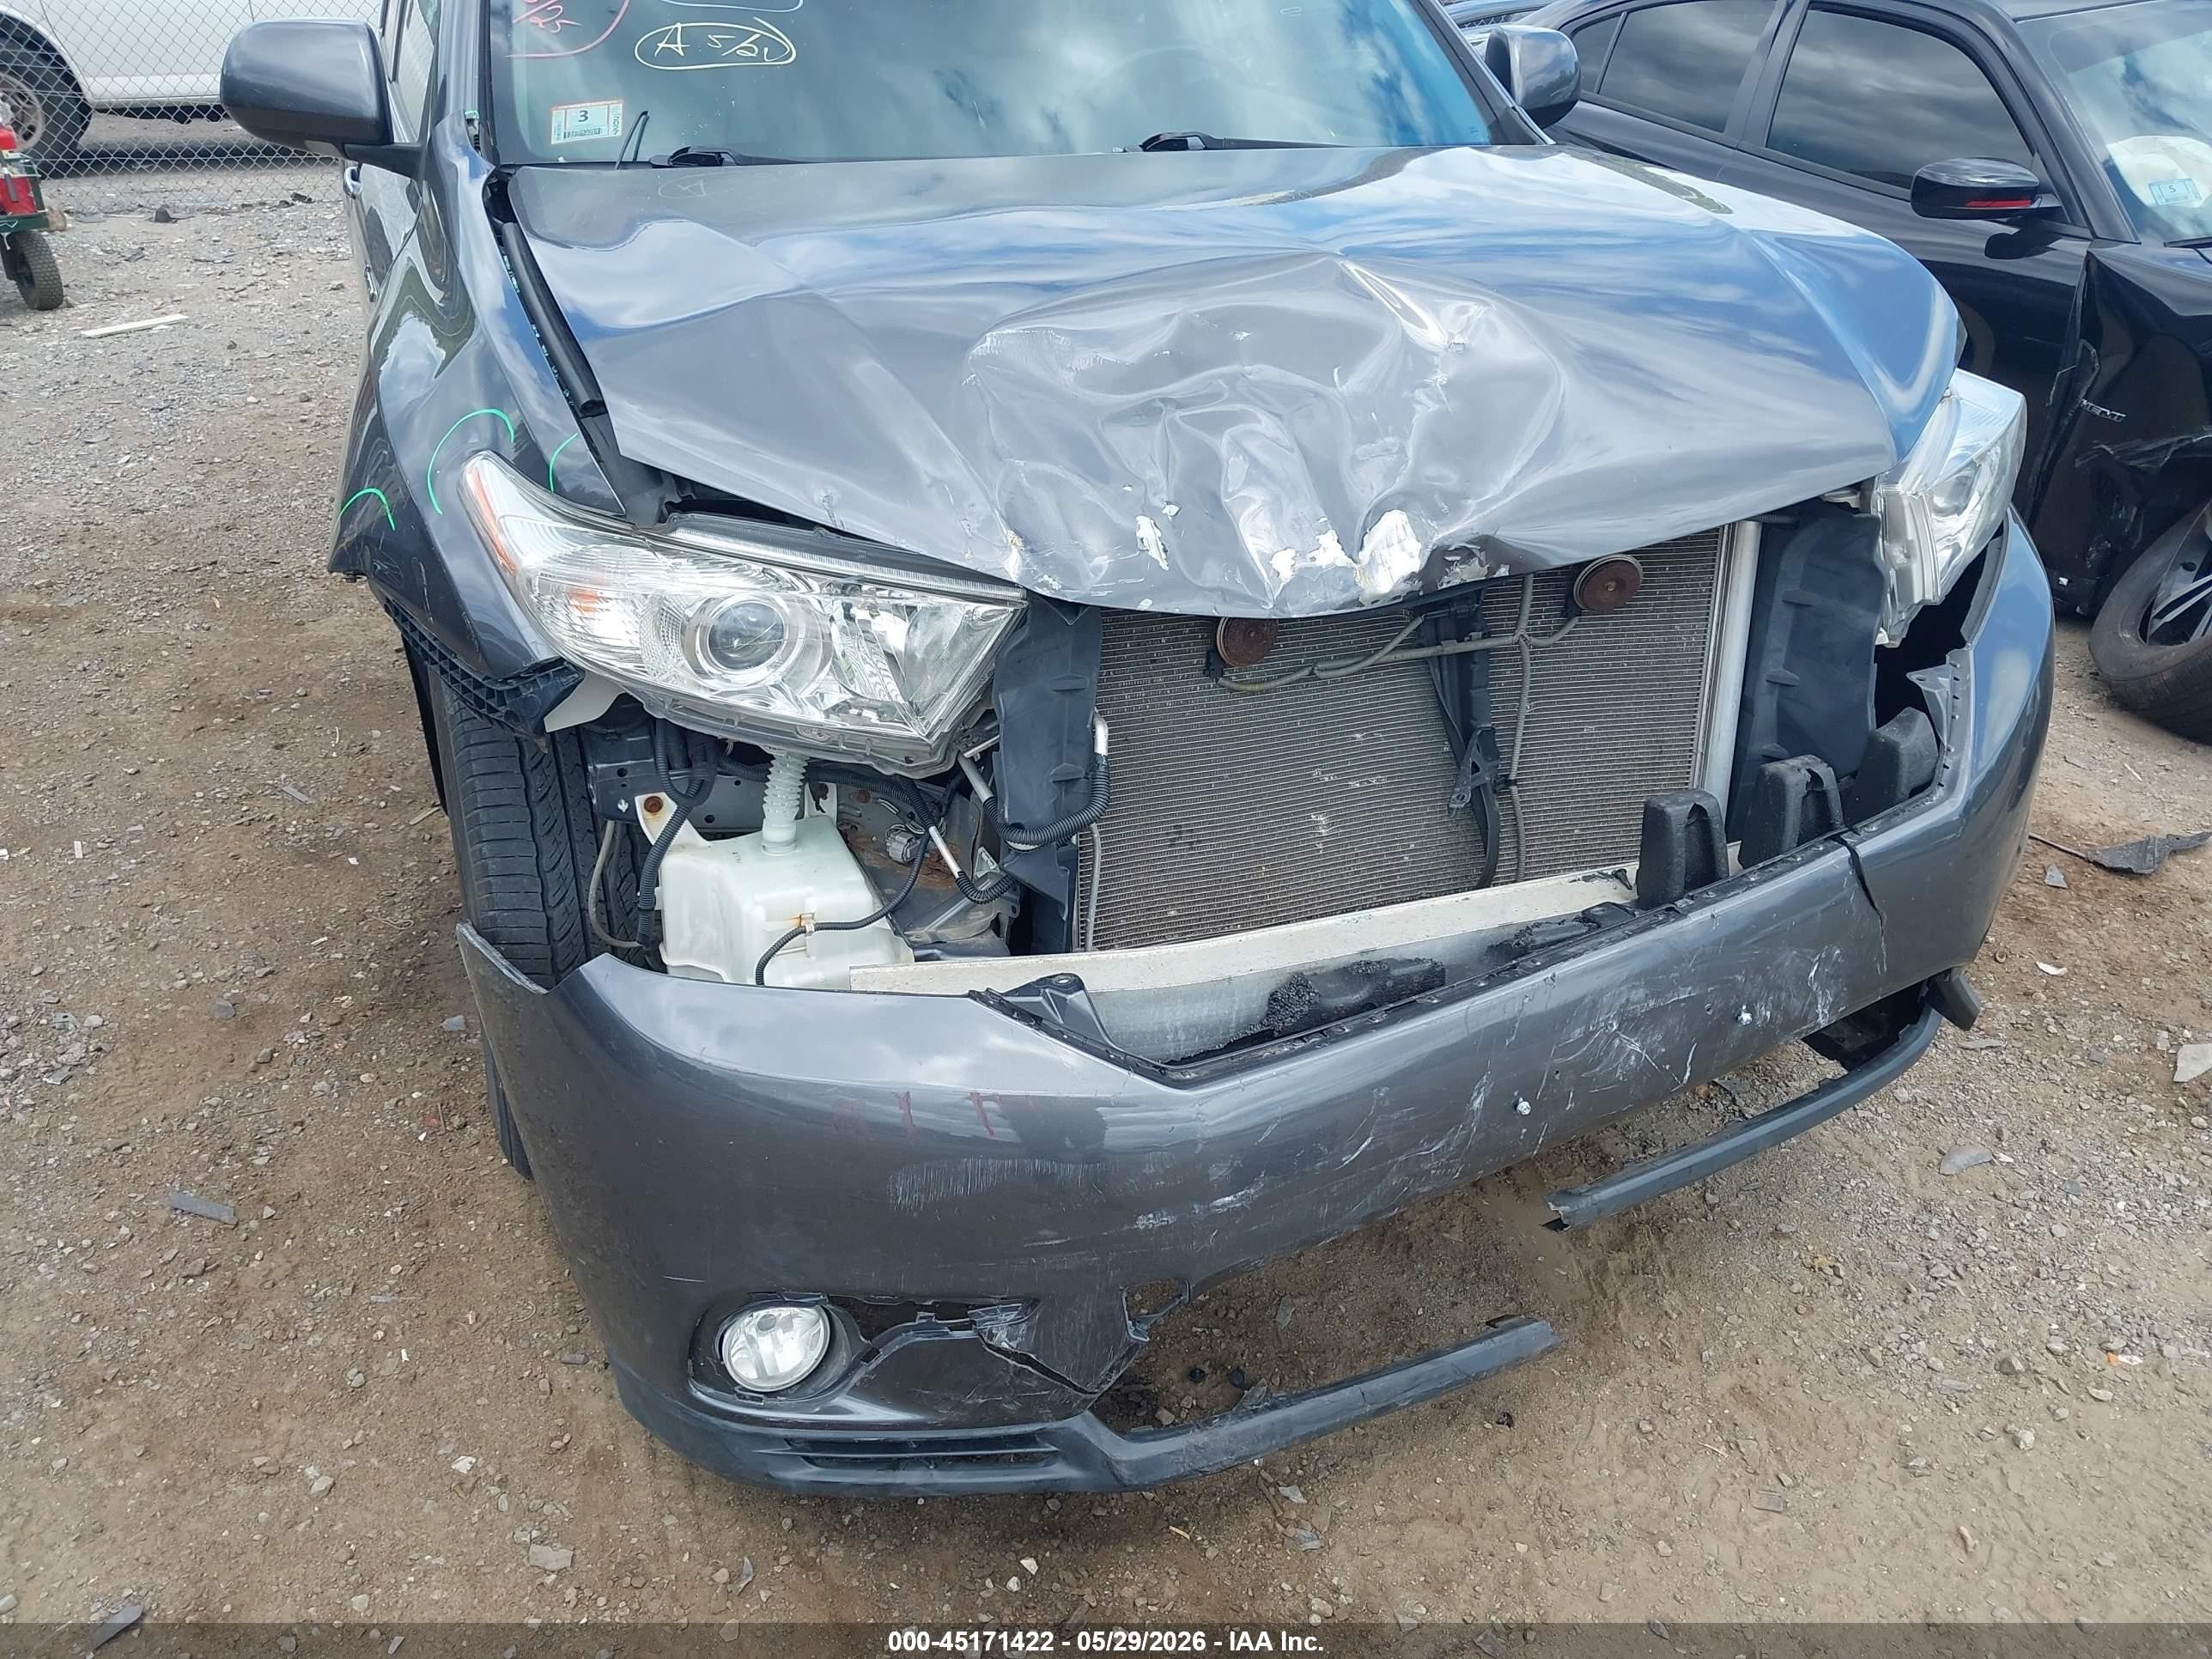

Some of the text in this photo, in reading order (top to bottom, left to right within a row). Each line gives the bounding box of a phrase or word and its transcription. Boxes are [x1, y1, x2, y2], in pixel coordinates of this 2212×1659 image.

[654, 22, 690, 58] A
[578, 110, 589, 123] 3
[2169, 185, 2177, 193] 5
